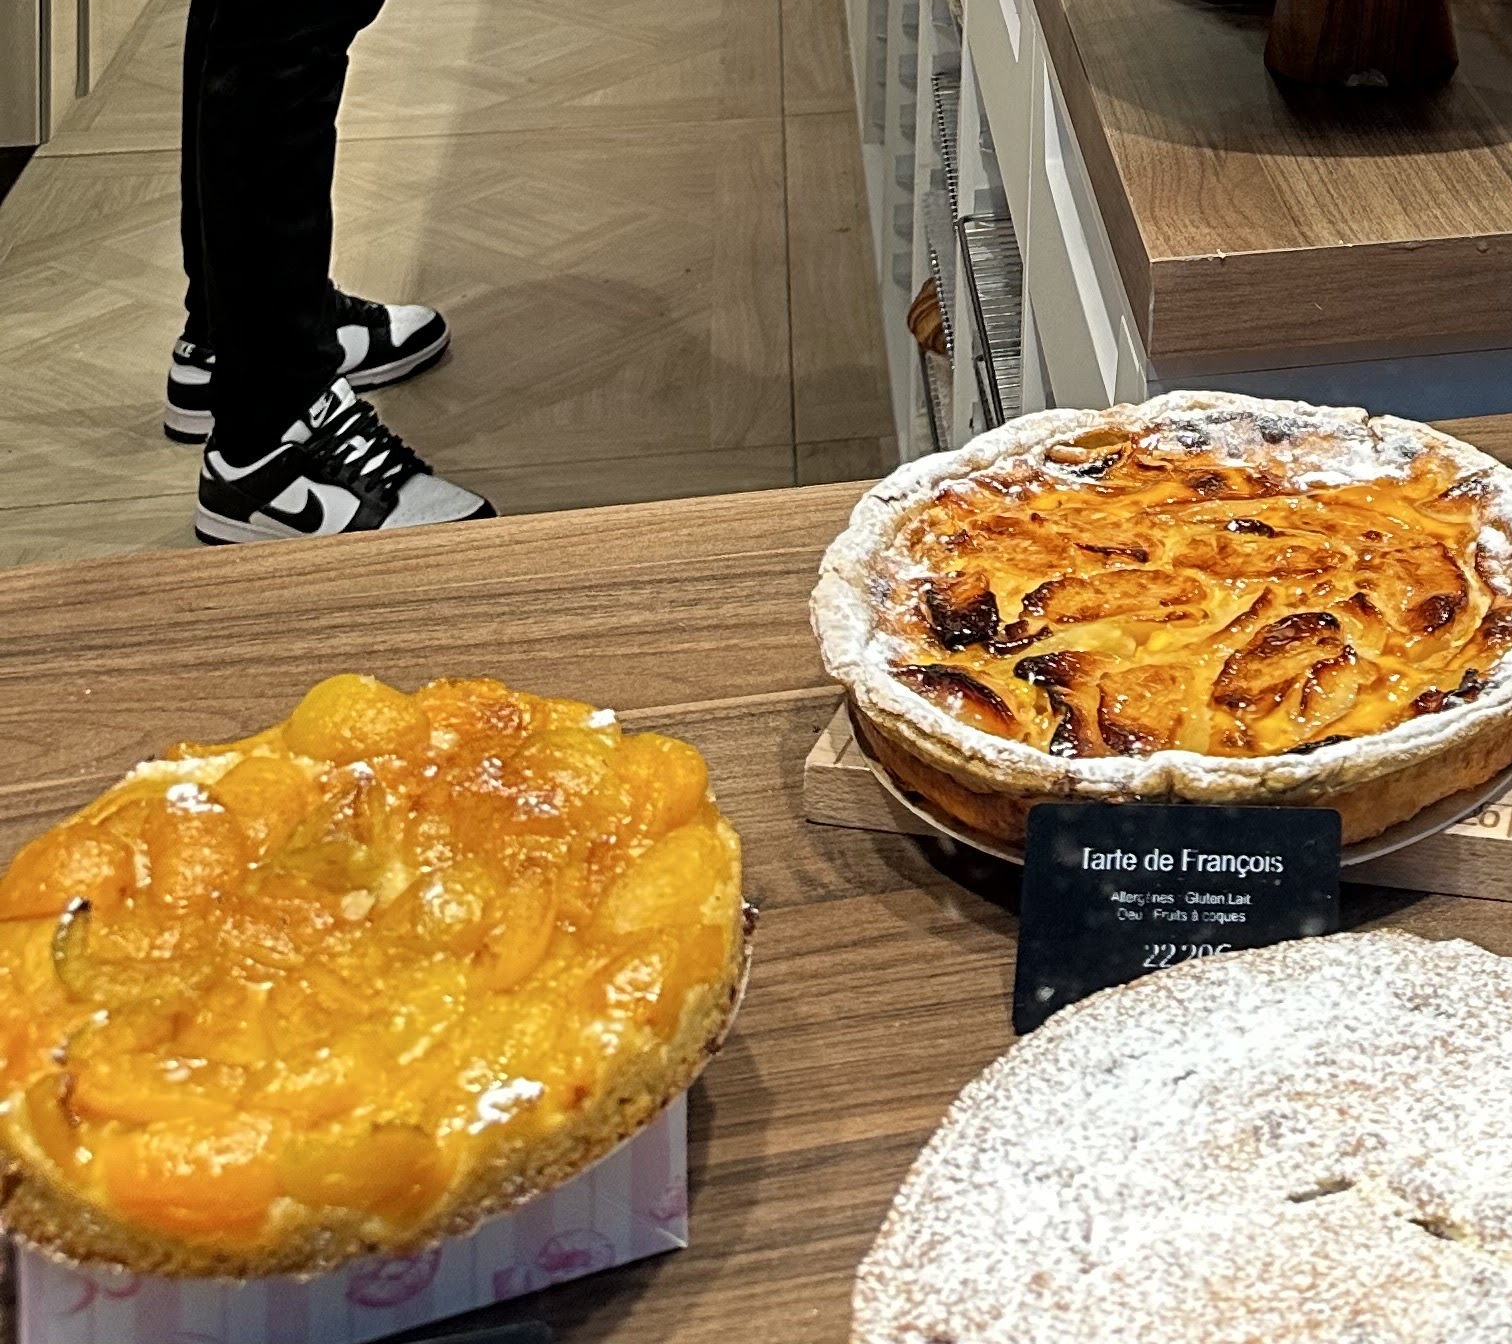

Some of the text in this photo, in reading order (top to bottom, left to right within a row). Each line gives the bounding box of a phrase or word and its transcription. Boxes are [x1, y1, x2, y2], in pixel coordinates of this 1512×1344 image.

[1082, 847, 1284, 879] Tarte de François
